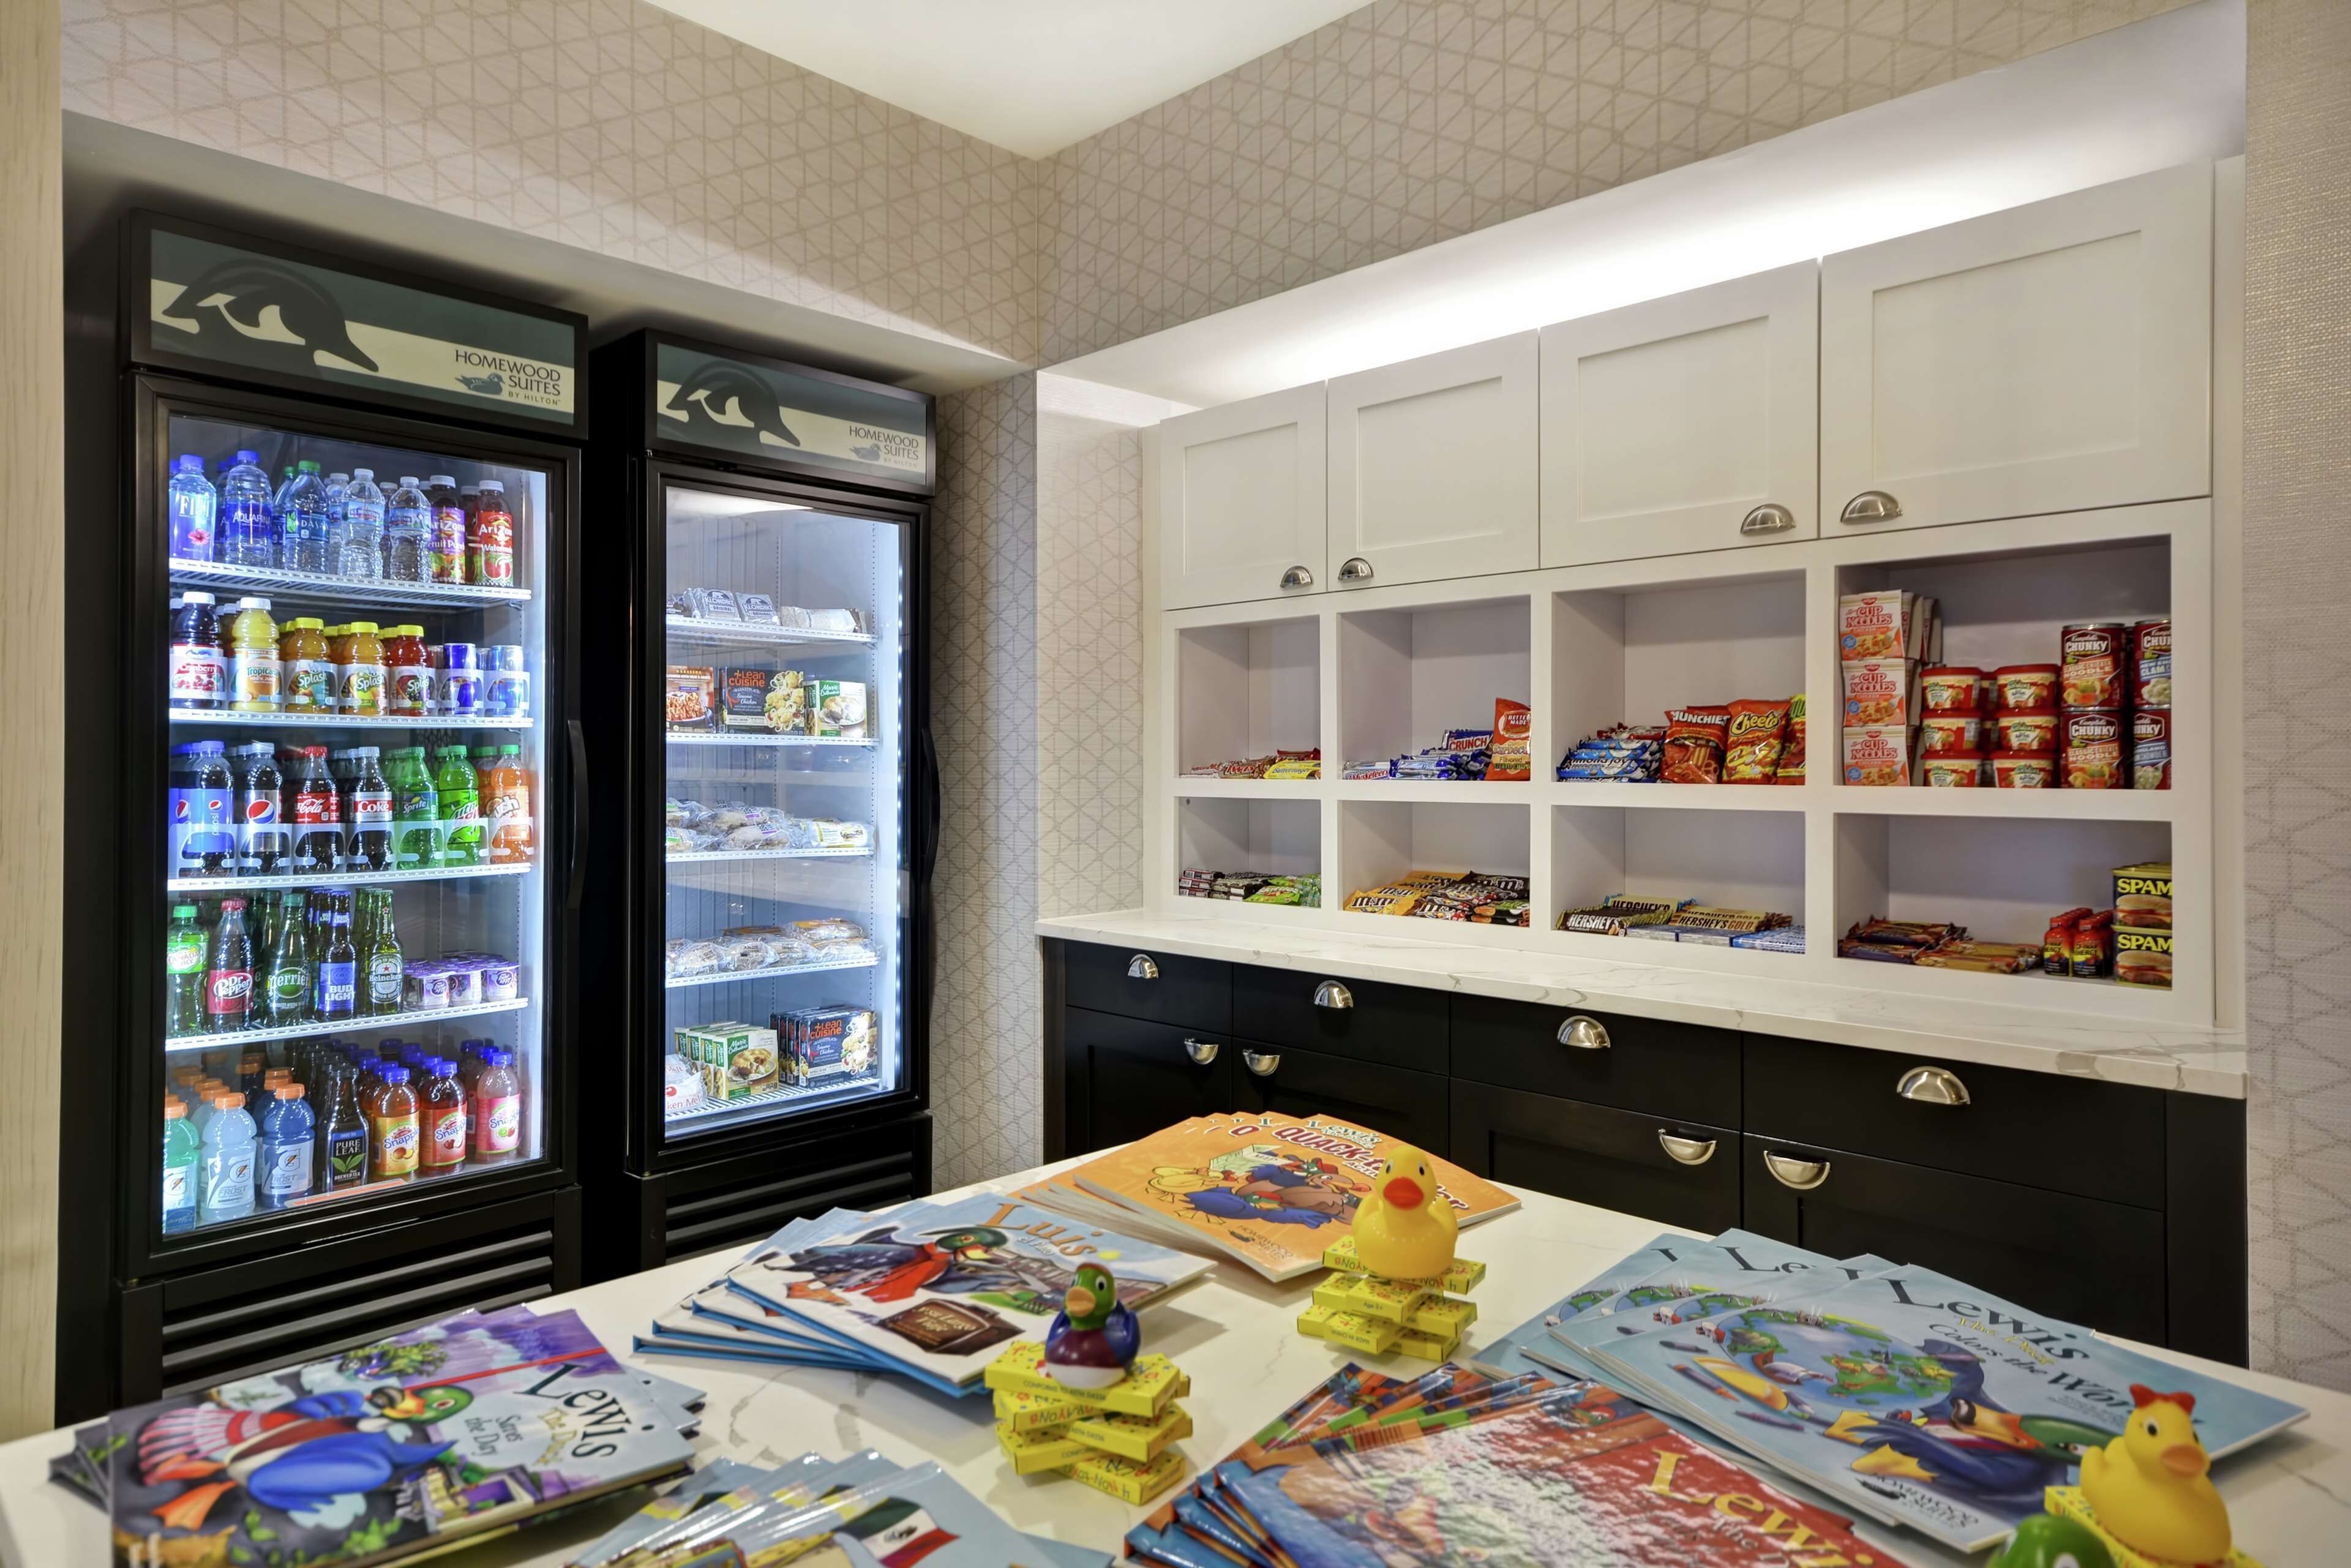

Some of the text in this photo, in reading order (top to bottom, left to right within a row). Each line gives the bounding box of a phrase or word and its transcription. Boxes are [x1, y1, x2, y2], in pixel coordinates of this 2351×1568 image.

[456, 350, 560, 381] HOMEWOOD
[509, 375, 560, 396] SUITES
[525, 394, 558, 405] HILTON
[849, 426, 918, 449] HOMEWOOD
[884, 445, 918, 459] SUITES
[705, 596, 735, 606] KLONDIKE
[743, 602, 773, 612] KLONDIKE
[1857, 606, 1883, 617] CUP
[1847, 613, 1892, 628] NOODLES
[2066, 641, 2107, 653] CHUNKY
[247, 666, 279, 677] Tropicana
[742, 670, 765, 679] Lean
[1859, 673, 1886, 683] CUP
[2064, 666, 2112, 678] NOODLE
[2141, 666, 2165, 676] CLAM
[298, 672, 328, 687] Splash
[356, 675, 384, 691] Splash
[1850, 681, 1896, 693] NOODLES
[1671, 711, 1730, 726] MUNCHIES
[2072, 725, 2115, 736] CHUNKY
[1450, 738, 1487, 751] CRUNCH
[1861, 740, 1888, 749] CUP
[1851, 748, 1897, 759] NOODLES
[2069, 752, 2118, 761] NOODLE
[1352, 770, 1389, 780] Musketeers
[299, 799, 326, 814] Cola
[359, 803, 389, 813] Coke
[403, 800, 429, 814] Sprite
[211, 812, 220, 836] pepsi
[2118, 878, 2173, 896] SPAM
[1568, 913, 1620, 929] HERSHEY'S
[1678, 915, 1753, 930] HERSHEY'S GOLD
[2118, 934, 2173, 953] SPAM
[215, 978, 251, 997] Pepper
[230, 976, 244, 985] Dr
[269, 972, 307, 989] Perrier
[325, 991, 356, 1001] LIGHT
[821, 1019, 842, 1030] Lean
[732, 1038, 746, 1048] Marie
[336, 1139, 360, 1149] PURE
[336, 1147, 360, 1156] LEAF
[979, 1202, 1104, 1256] Luis
[1450, 1279, 1457, 1291] 4
[1879, 1278, 2090, 1360] Lewis
[1331, 1329, 1347, 1338] CHINA
[1959, 1317, 1999, 1337] The
[1929, 1324, 2047, 1375] Colors the
[1024, 1380, 1059, 1394] CONFORMS
[512, 1363, 632, 1457] Lewis
[538, 1408, 568, 1430] The
[496, 1414, 523, 1442] Saves
[465, 1417, 500, 1456] the Day
[1122, 1484, 1130, 1499] 4
